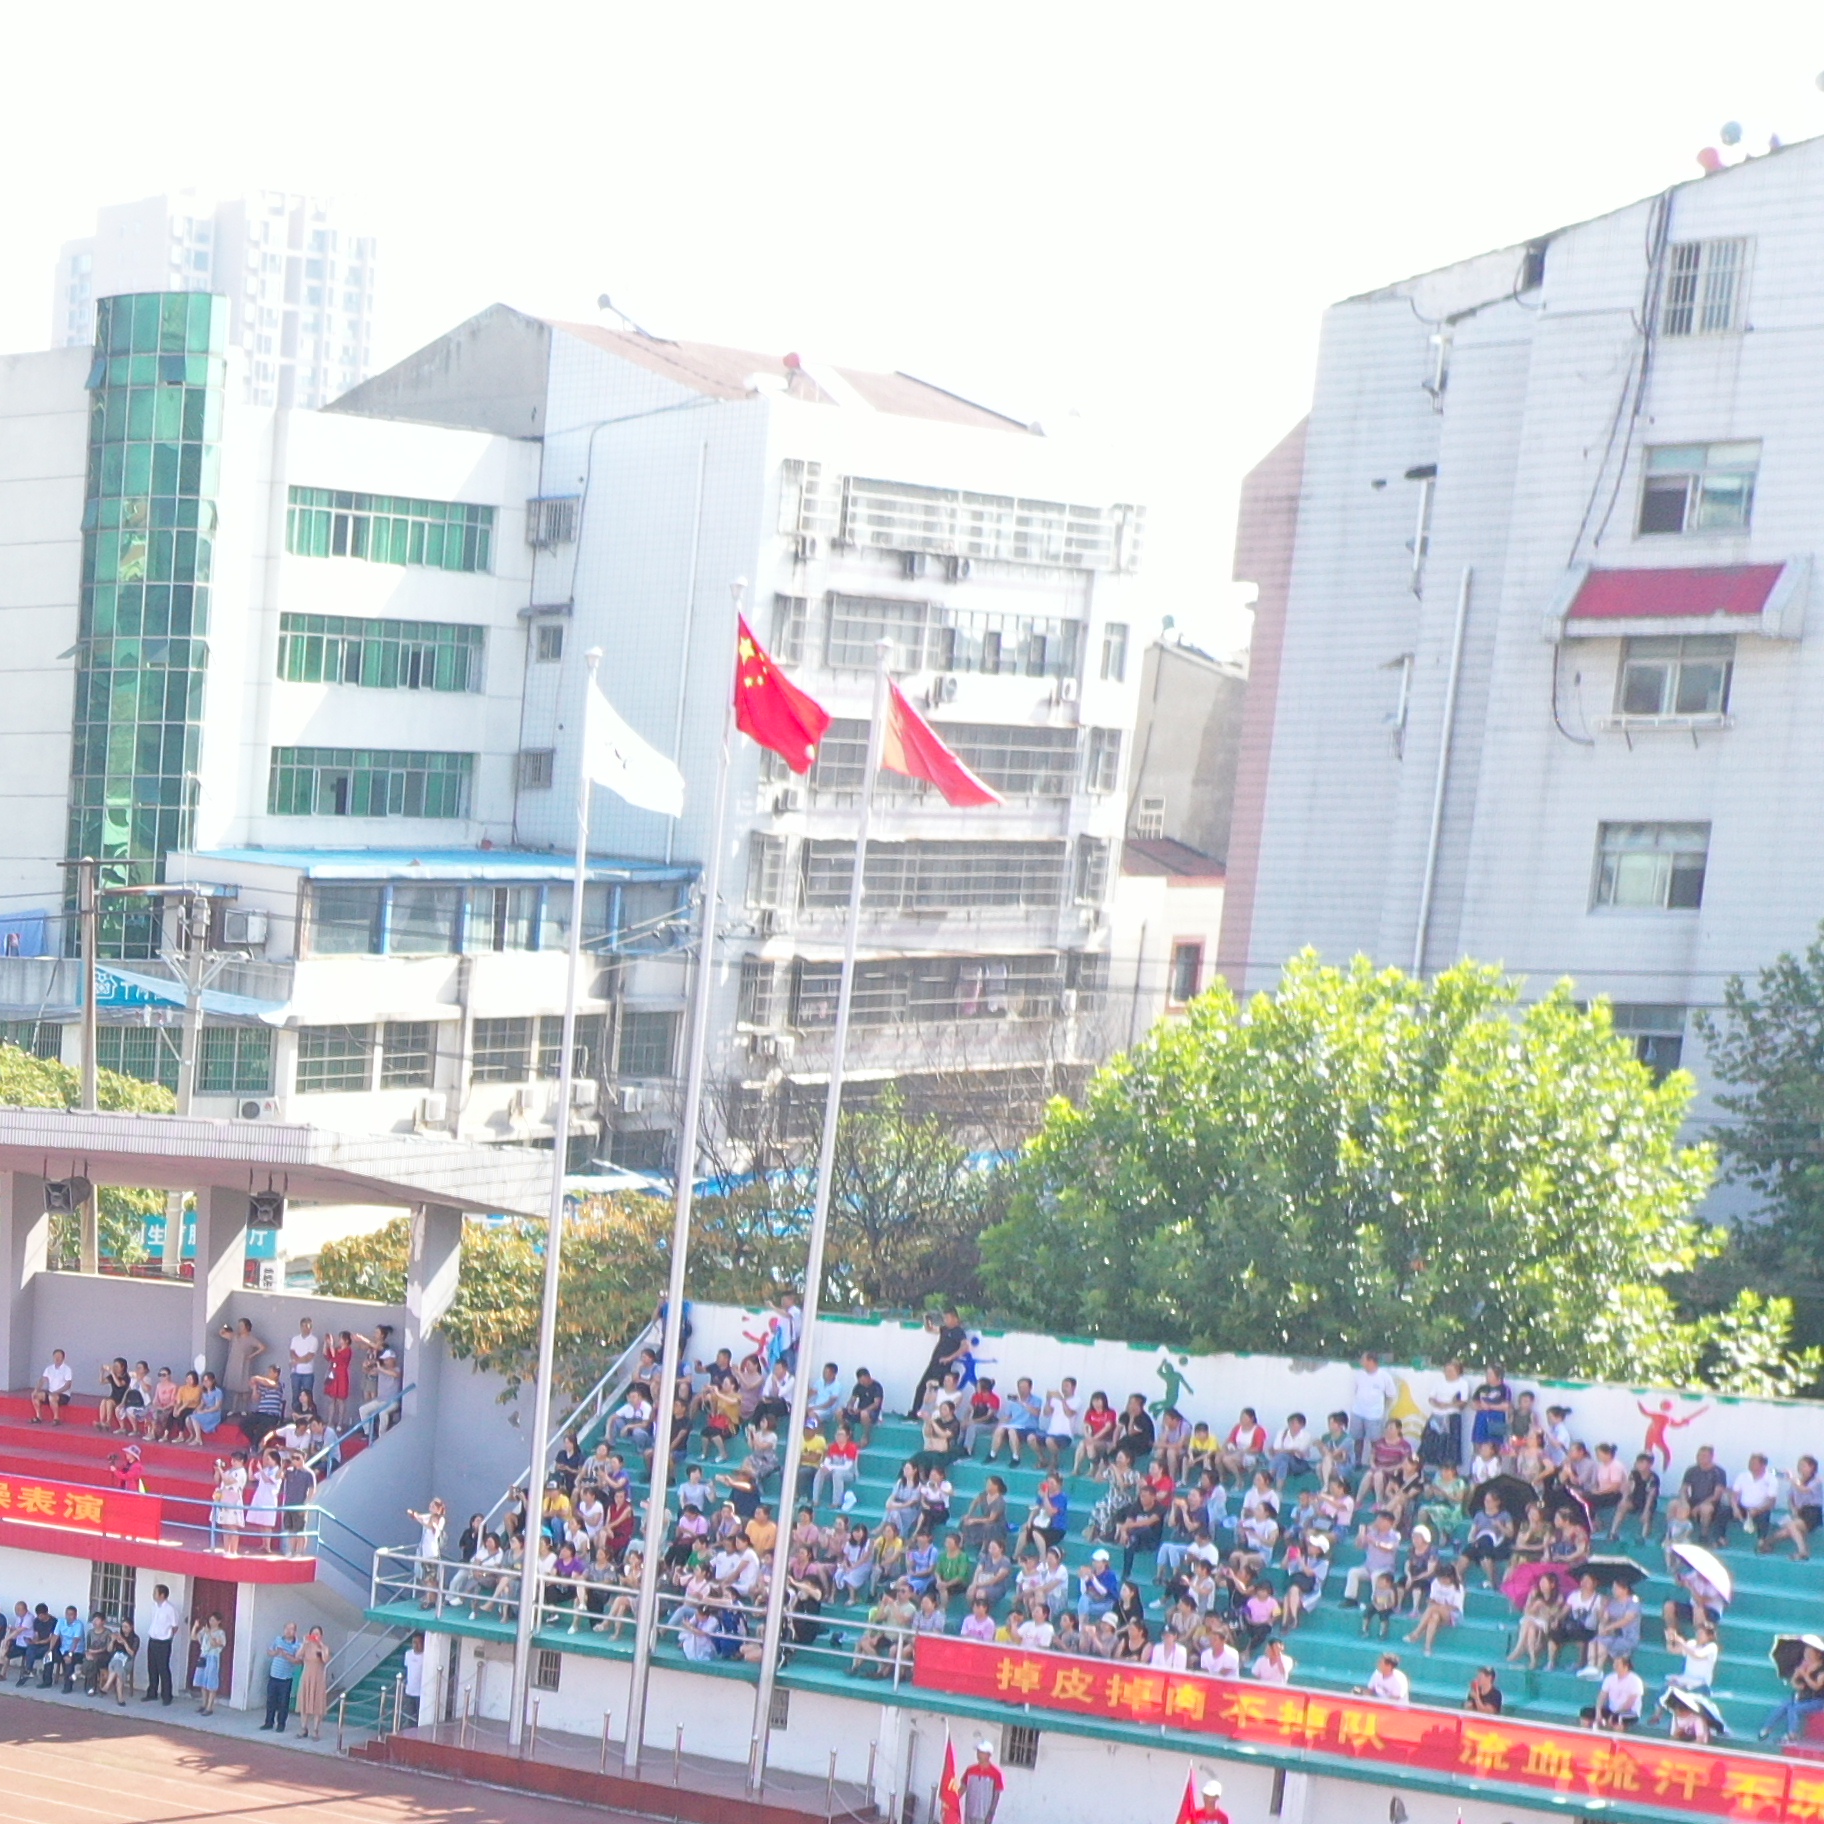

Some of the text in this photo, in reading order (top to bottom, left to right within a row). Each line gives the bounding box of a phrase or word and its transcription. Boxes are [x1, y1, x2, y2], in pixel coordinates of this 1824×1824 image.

[996, 1657, 1386, 1751] 掉皮掉肉不掉队
